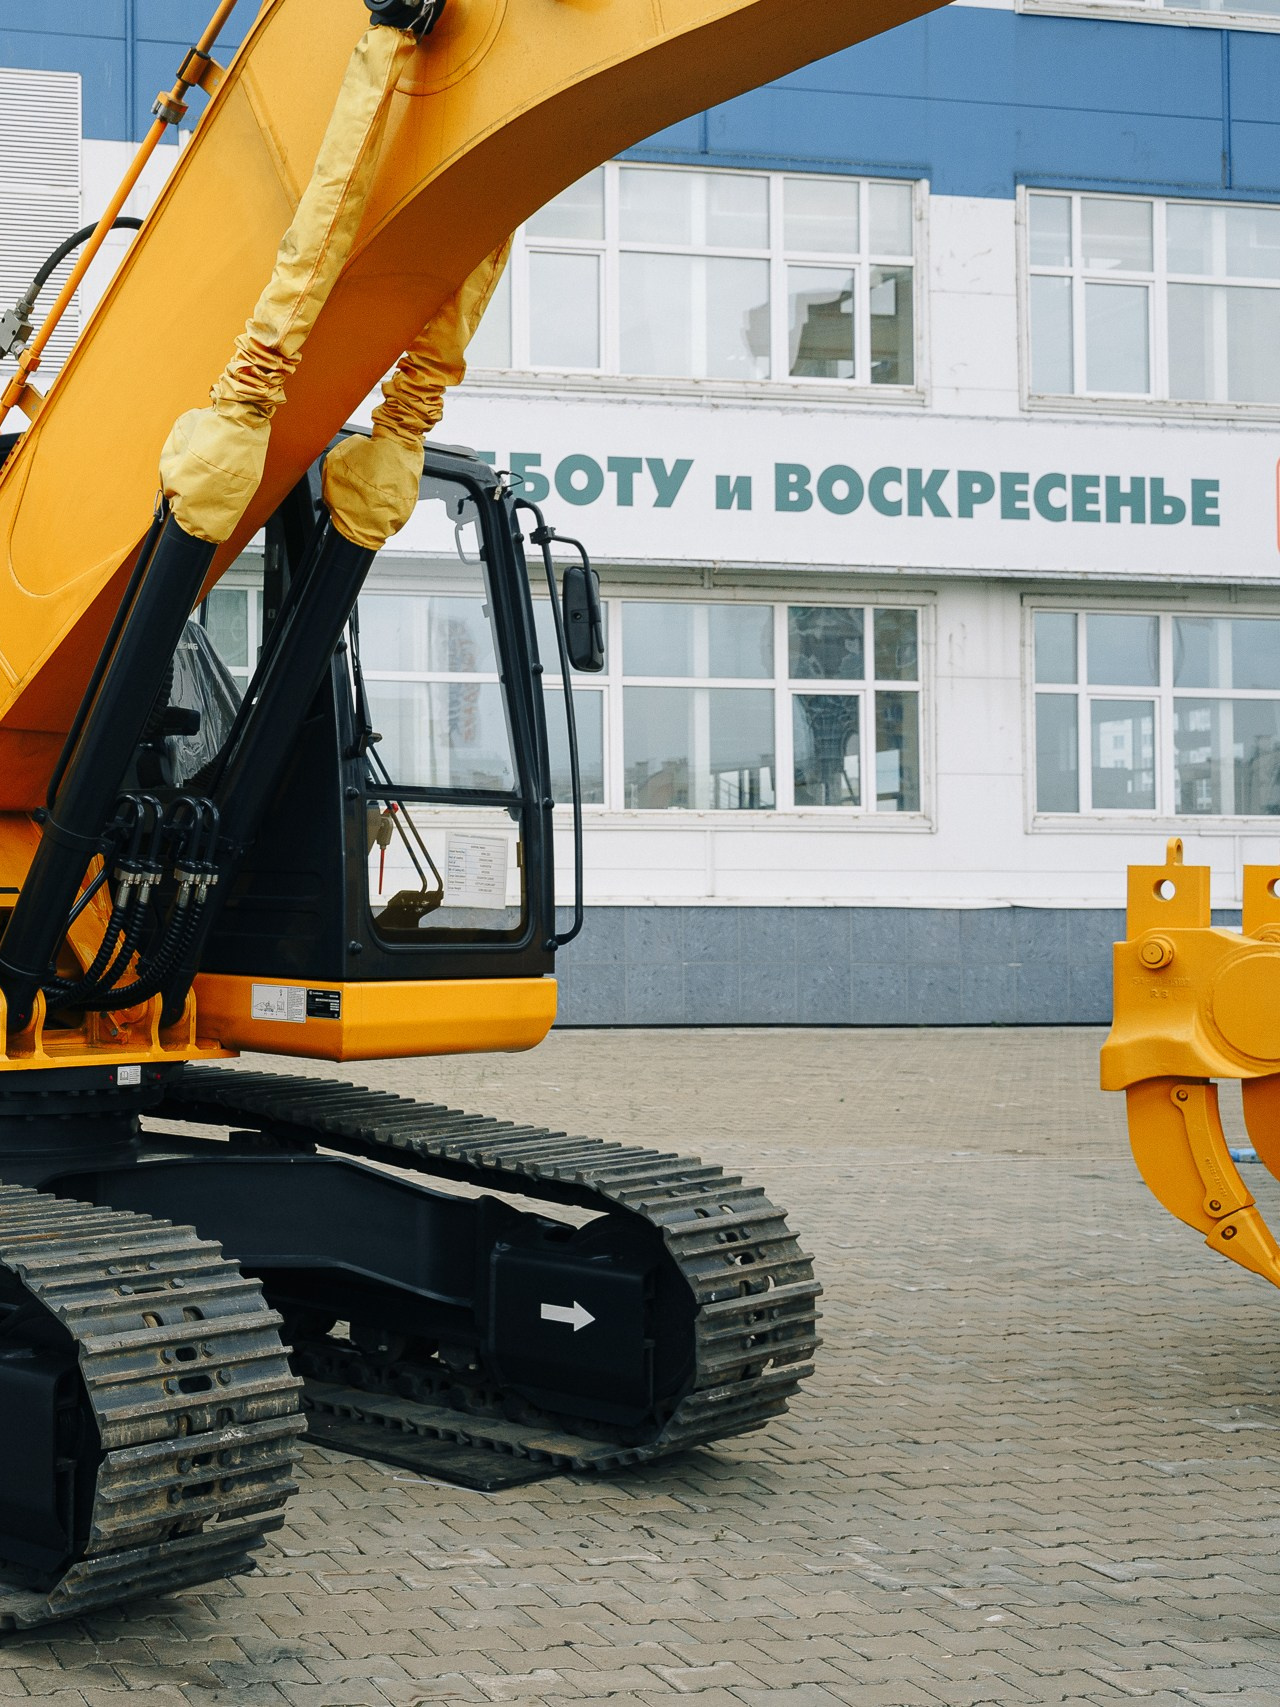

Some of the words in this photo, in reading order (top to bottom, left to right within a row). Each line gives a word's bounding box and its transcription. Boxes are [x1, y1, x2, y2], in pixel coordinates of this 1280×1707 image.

[477, 451, 694, 508] БОТУ
[716, 473, 753, 511] и
[774, 462, 1221, 527] ВОСКРЕСЕНЬЕ
